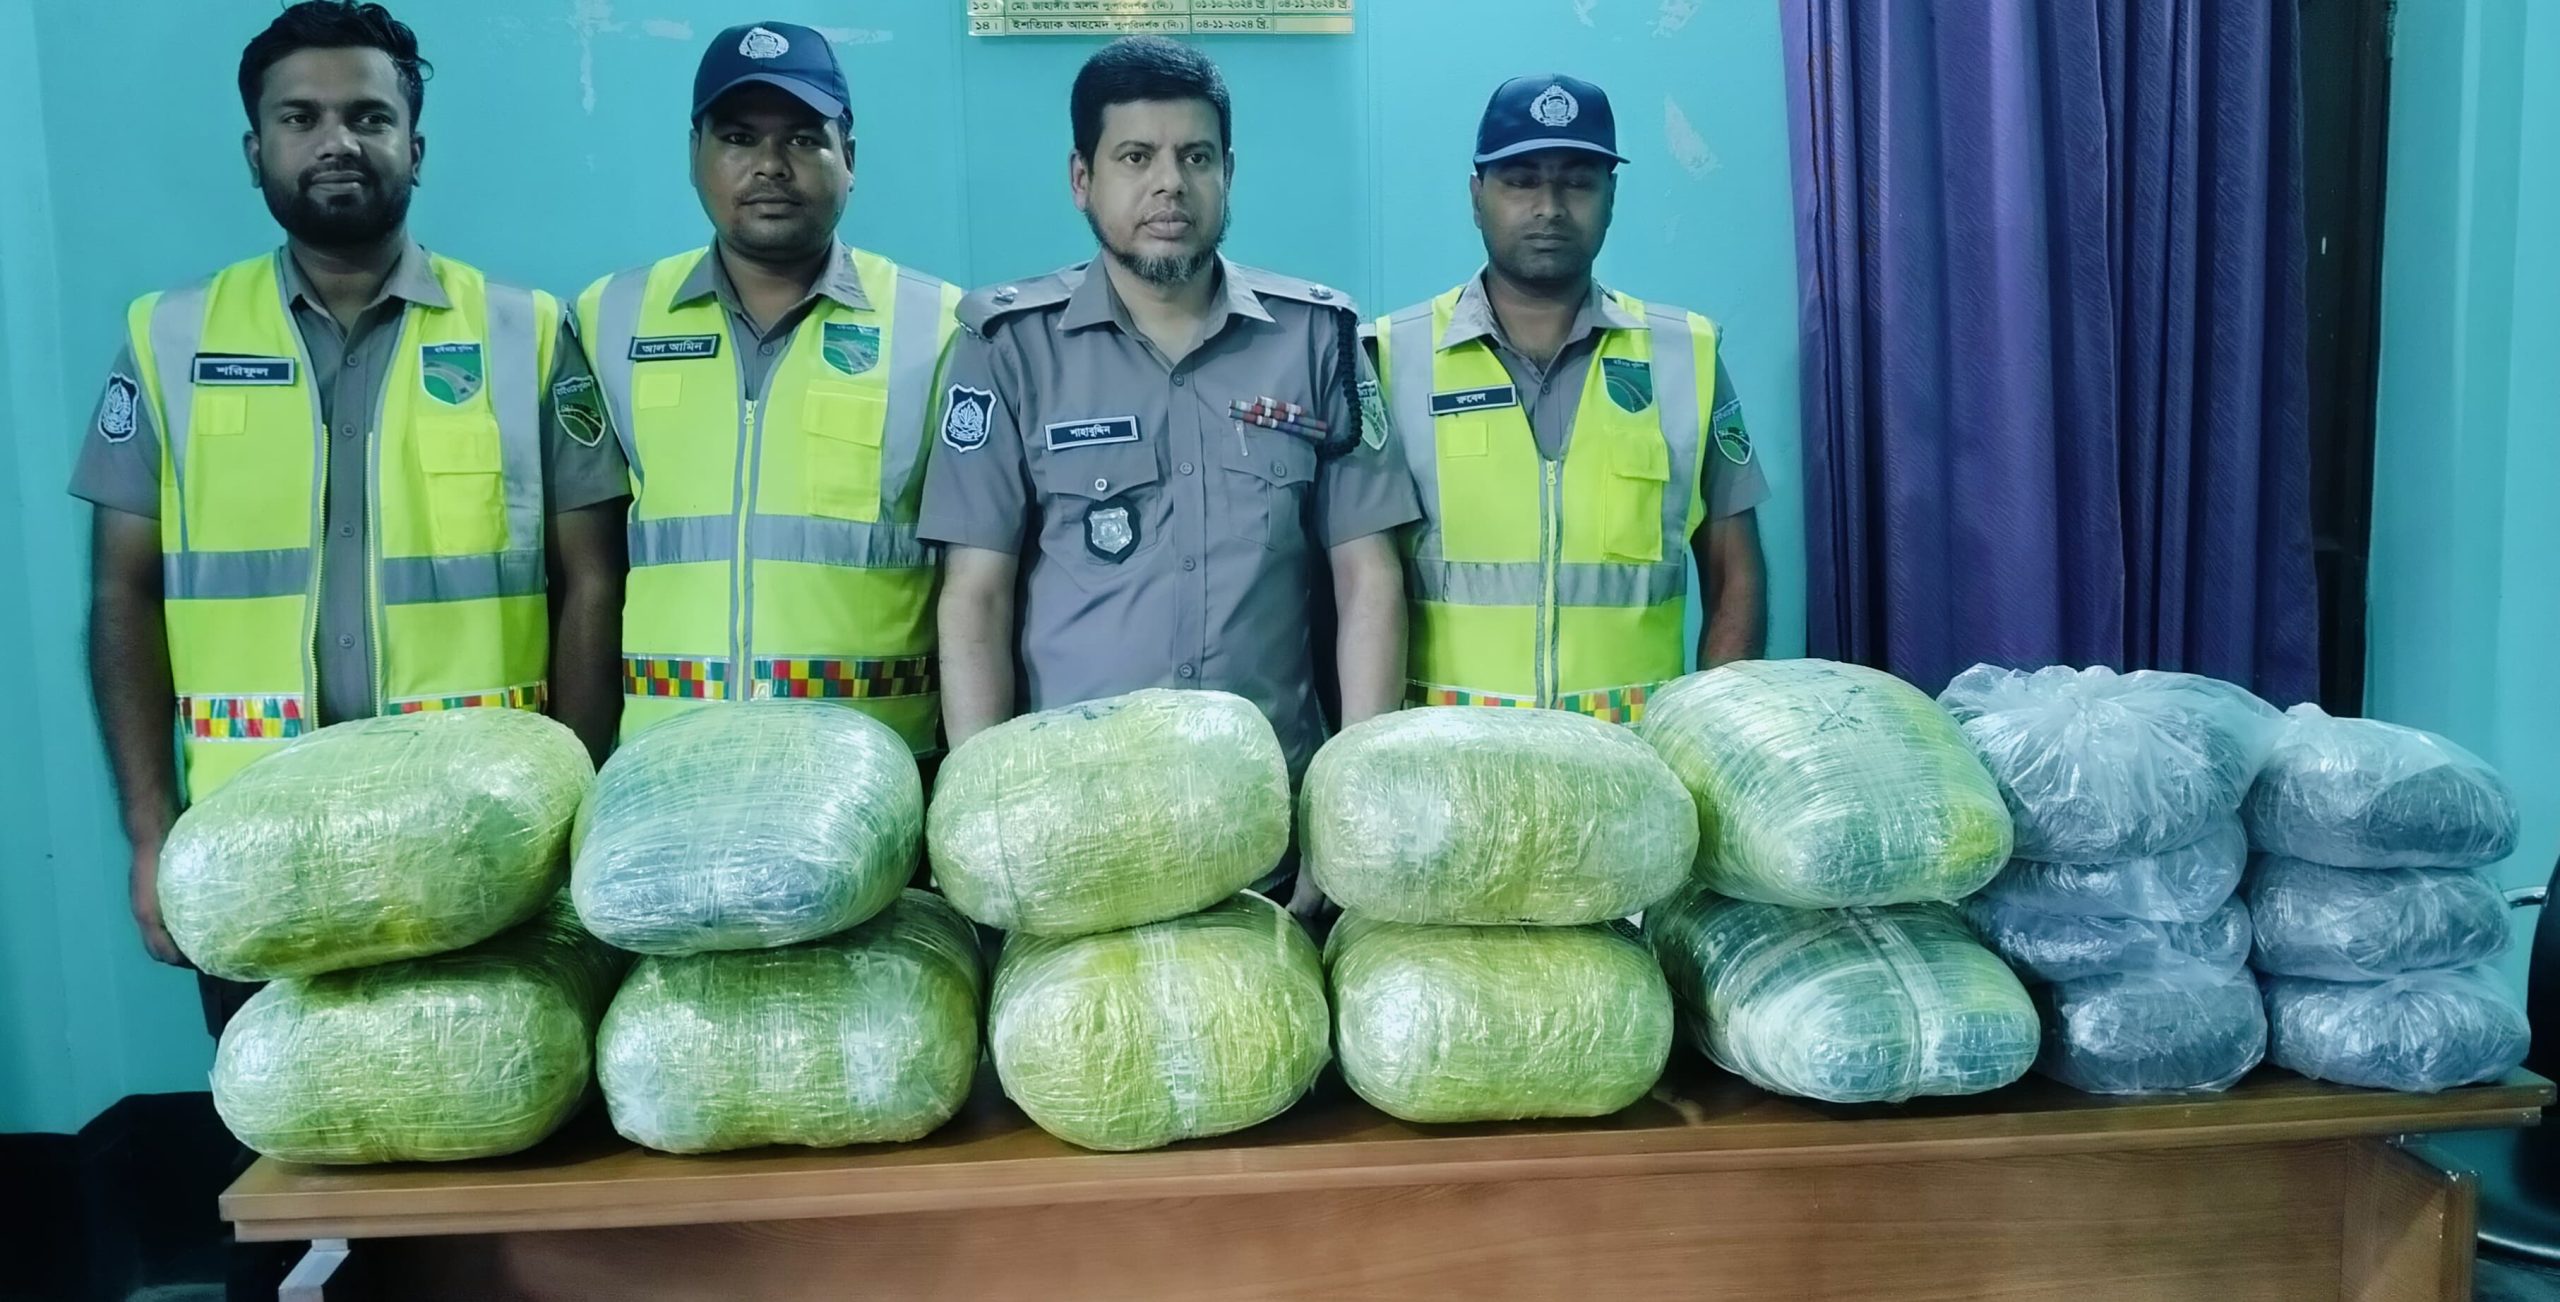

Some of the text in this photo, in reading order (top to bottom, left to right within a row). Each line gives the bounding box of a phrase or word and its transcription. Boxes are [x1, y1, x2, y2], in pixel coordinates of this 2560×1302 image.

[1067, 20, 1109, 30] আহমেদ
[1196, 20, 1254, 29] ০৪-১১-২০২৪
[641, 339, 705, 354] আল আমিন
[215, 364, 269, 378] শরিফুল
[1456, 392, 1486, 404] রুবেল
